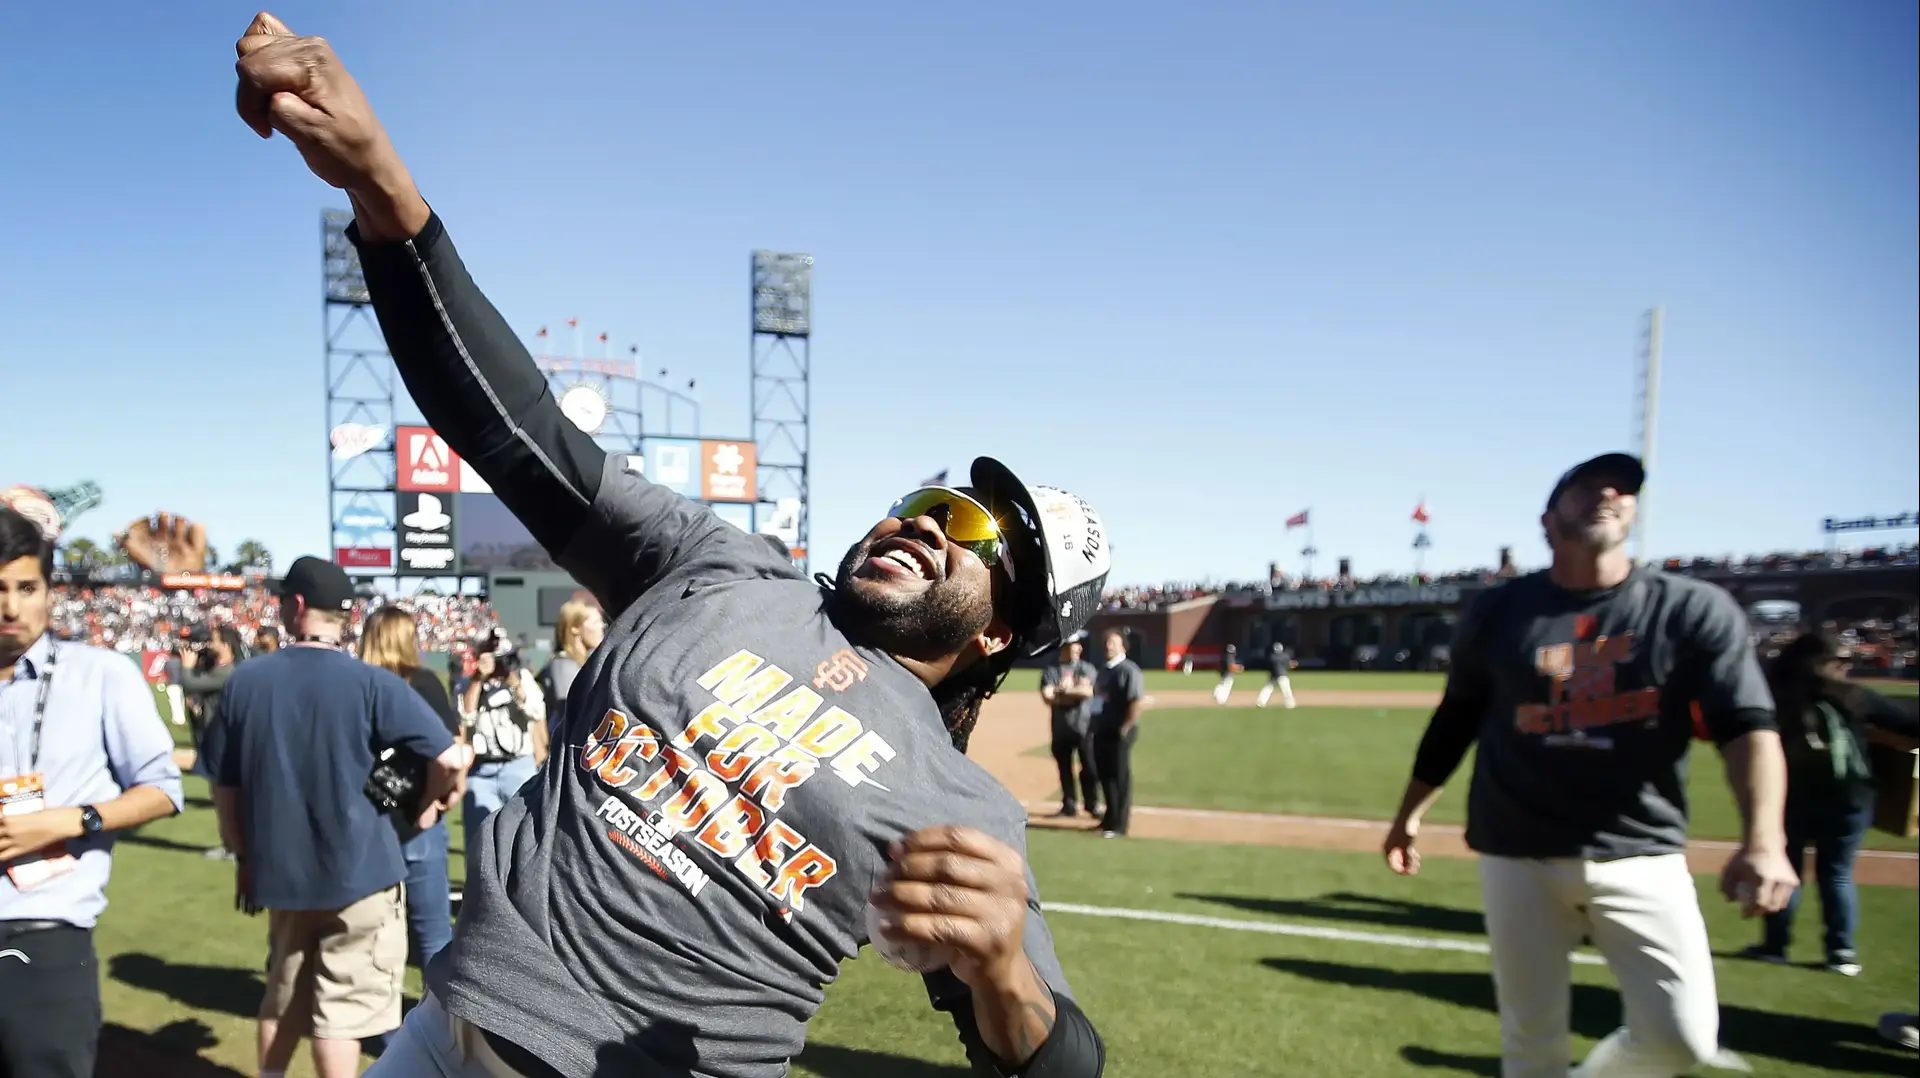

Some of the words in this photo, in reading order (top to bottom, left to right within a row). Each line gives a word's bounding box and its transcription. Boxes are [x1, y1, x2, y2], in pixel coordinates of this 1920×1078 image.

[671, 700, 820, 813] FOR
[696, 649, 896, 791] MADE
[580, 708, 838, 912] OCTOBER
[596, 796, 710, 898] POSTSEASON
